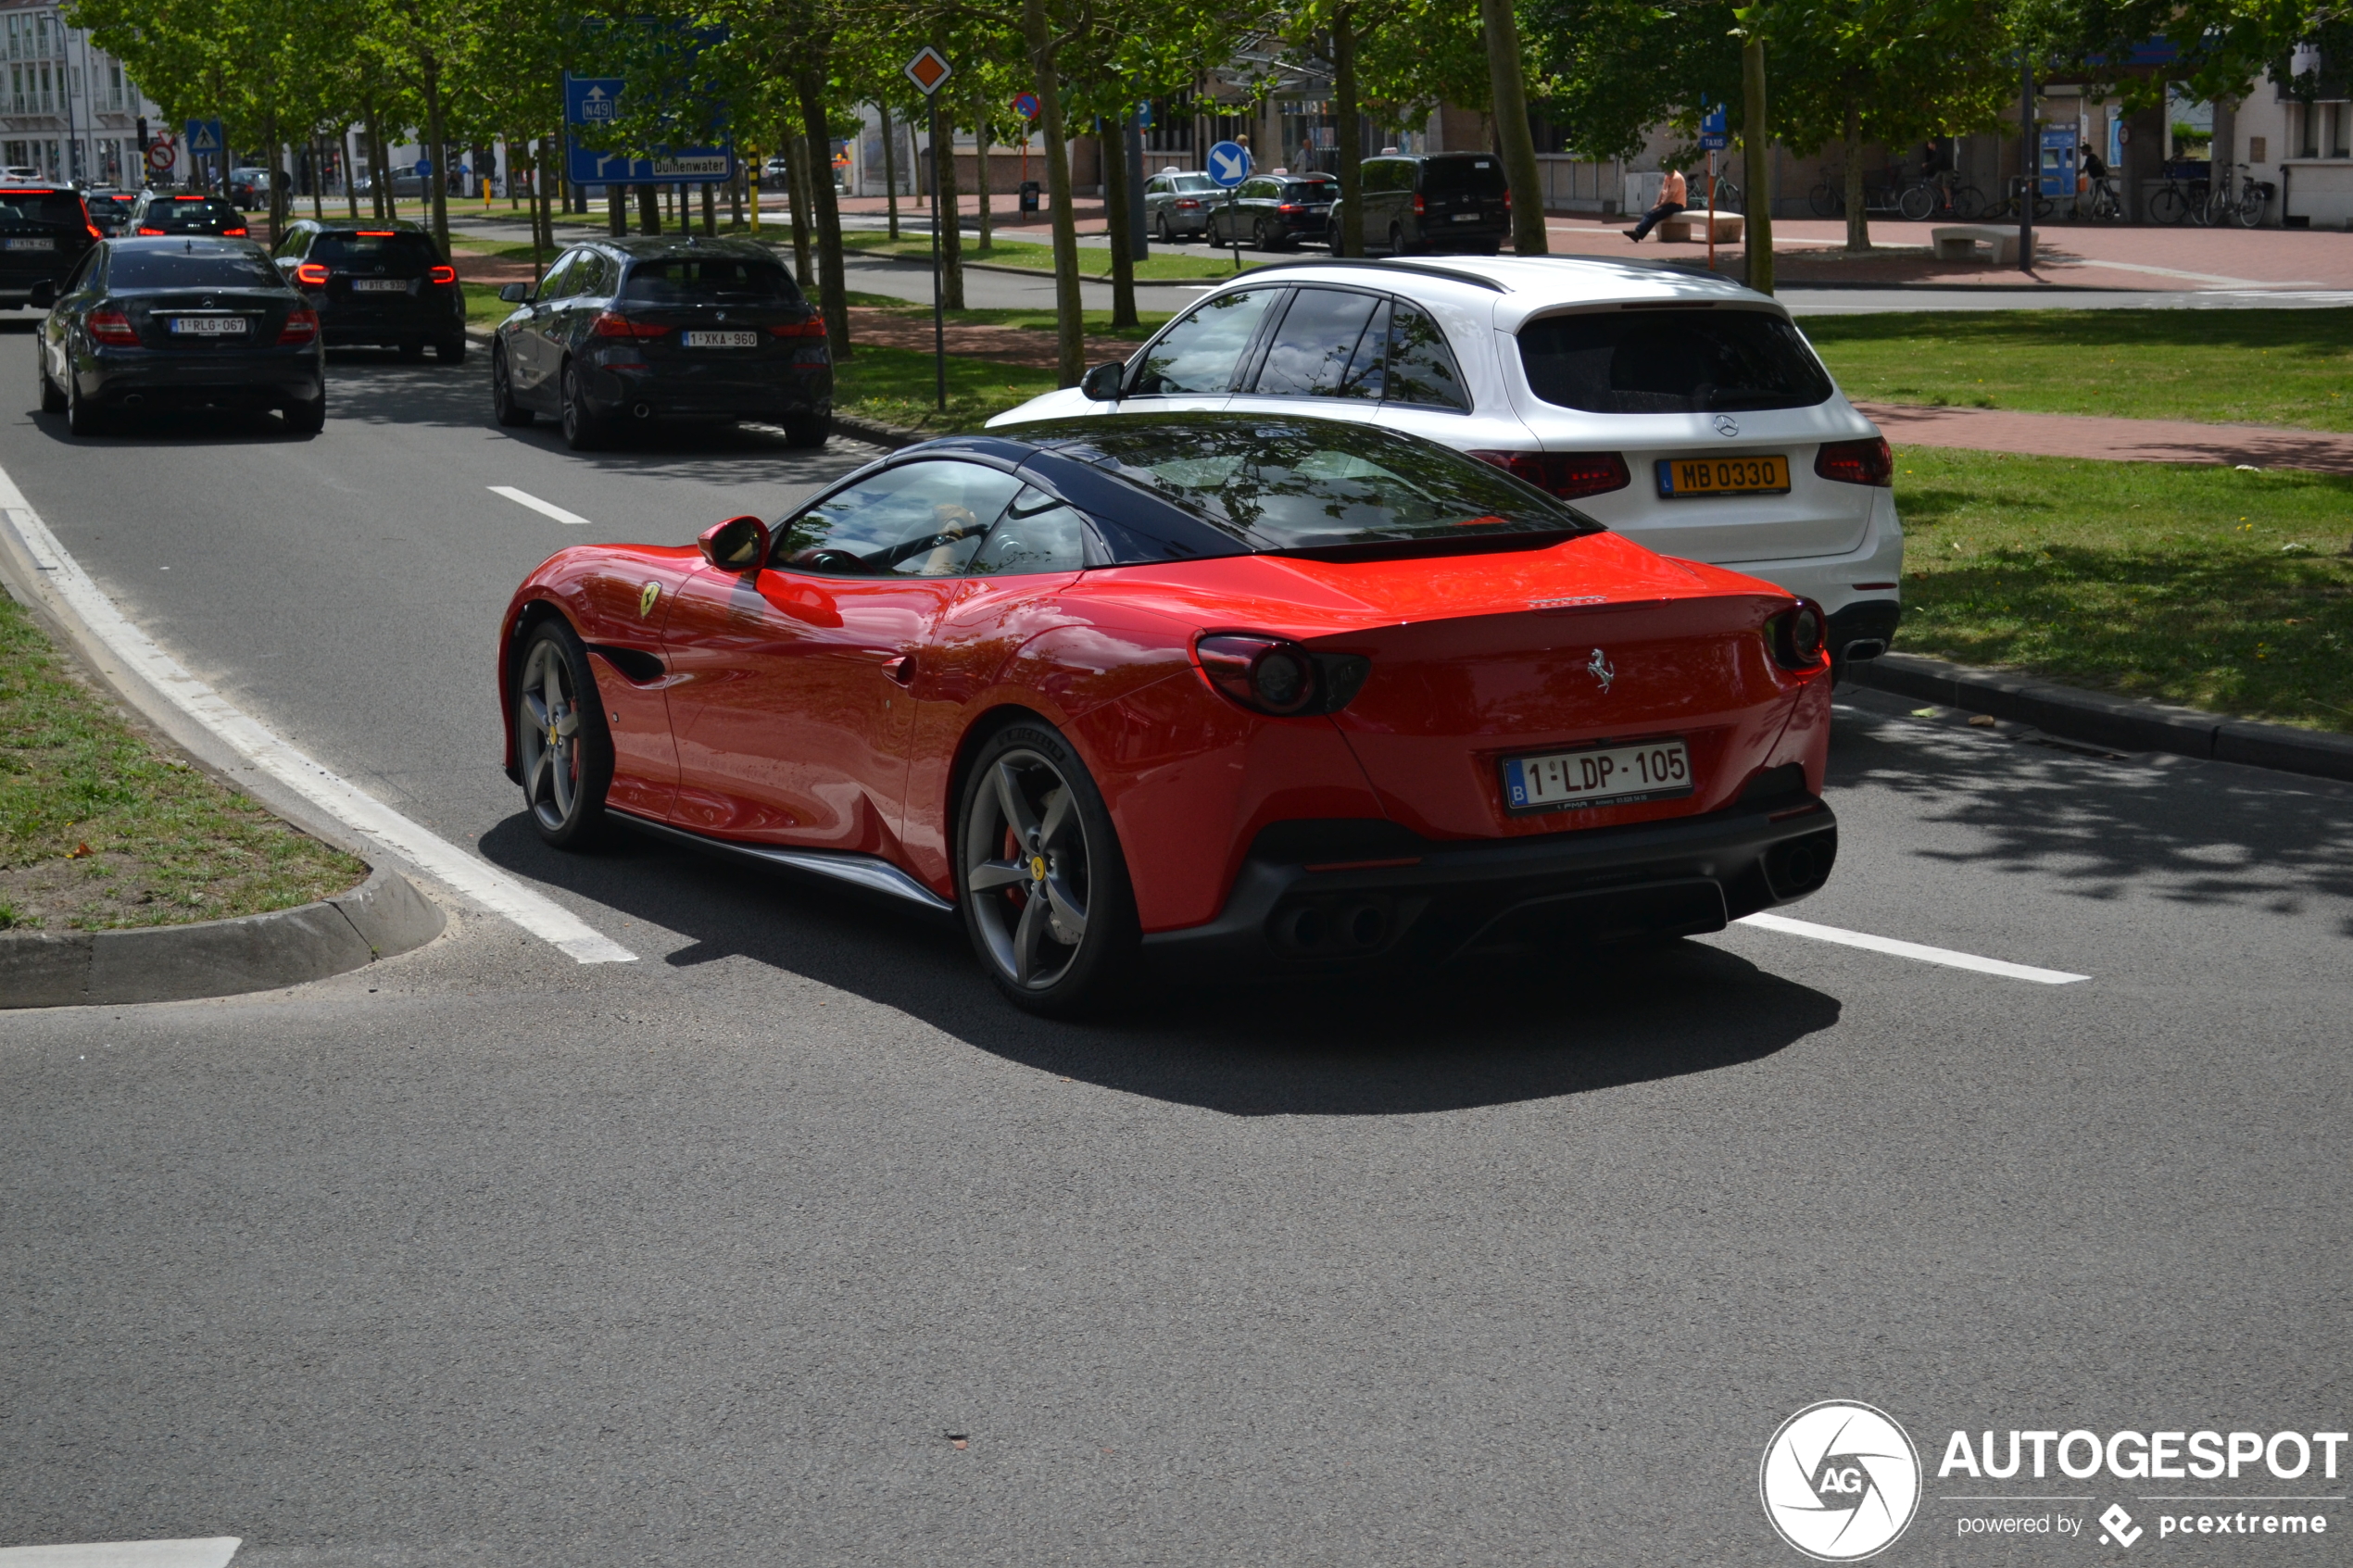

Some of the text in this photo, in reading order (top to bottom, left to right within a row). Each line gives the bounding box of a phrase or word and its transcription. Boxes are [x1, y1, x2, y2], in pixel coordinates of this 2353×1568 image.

[585, 103, 609, 116] N49
[180, 320, 244, 331] 1-RLG-067
[691, 333, 755, 345] 1-XKA-960
[1664, 461, 1775, 488] L MB 0330
[1513, 748, 1685, 801] B 1-LDP-105
